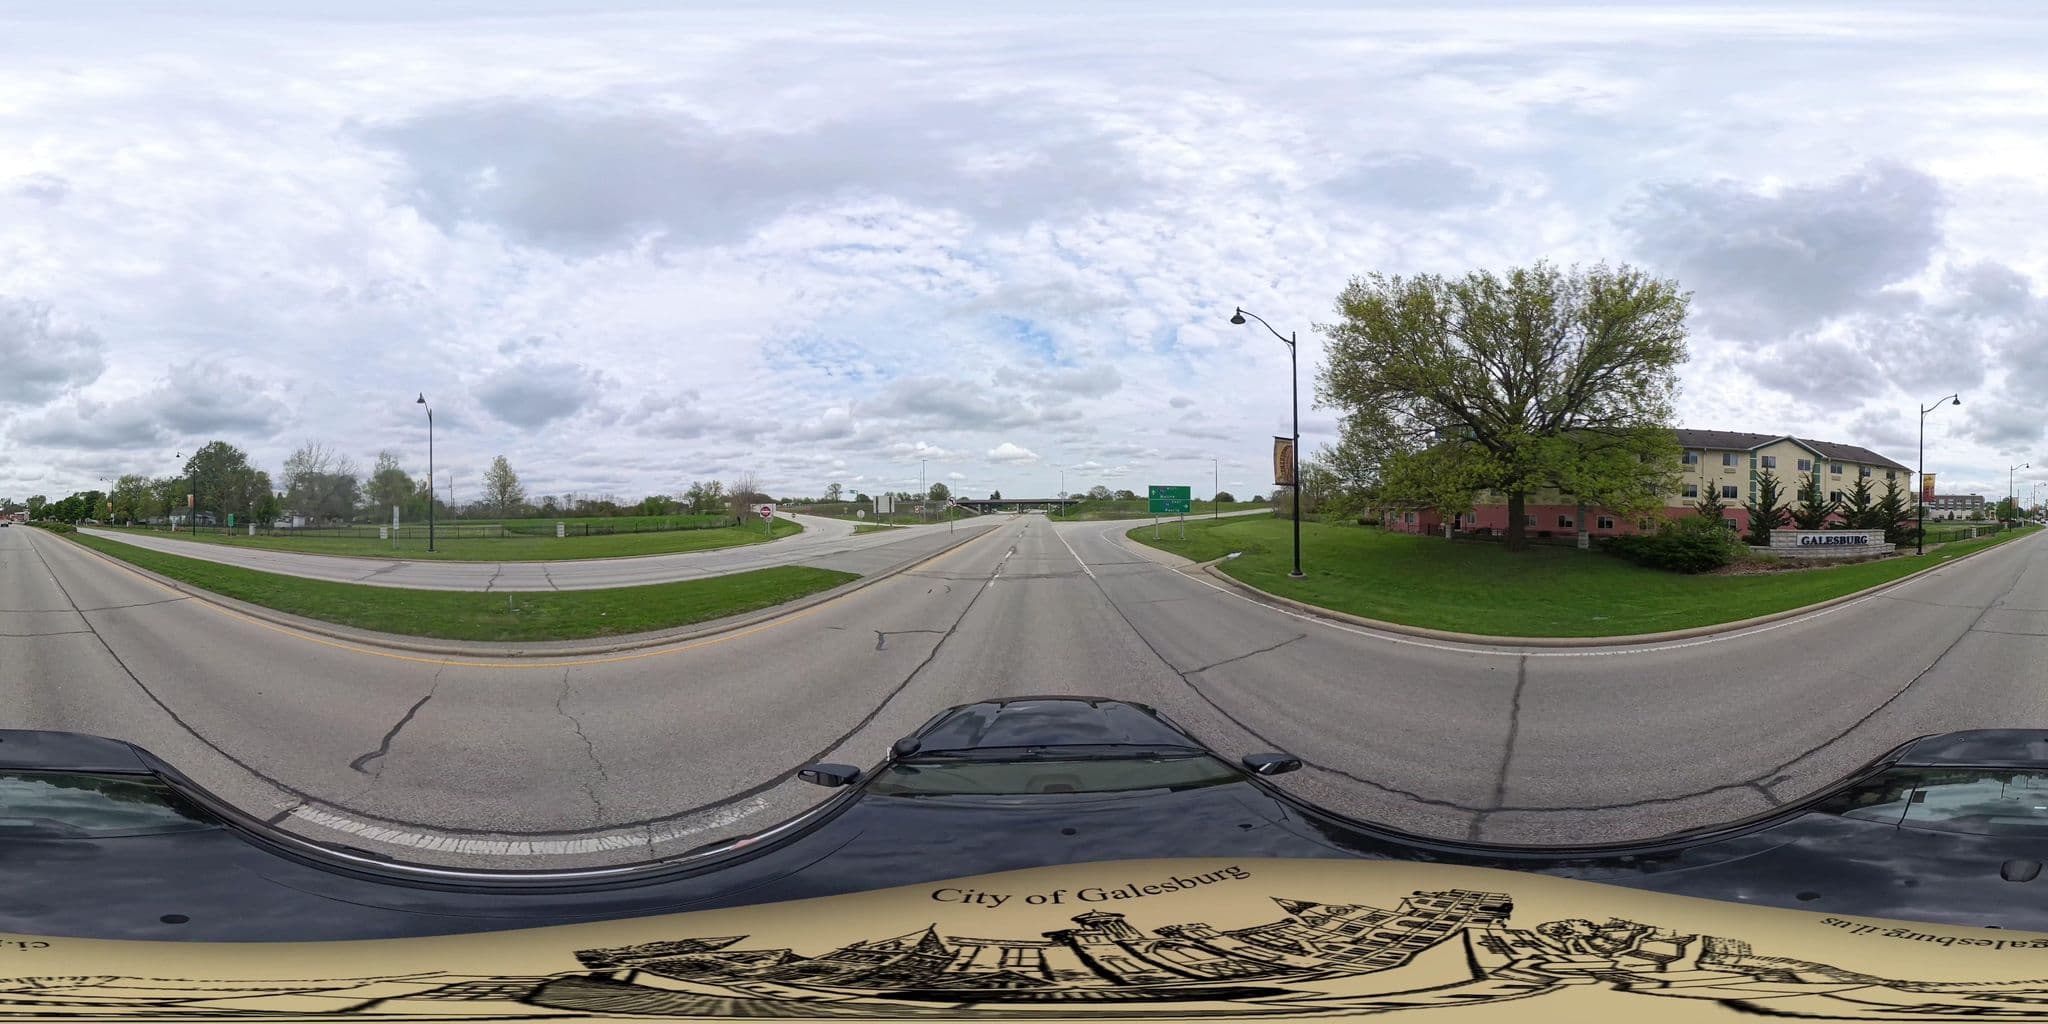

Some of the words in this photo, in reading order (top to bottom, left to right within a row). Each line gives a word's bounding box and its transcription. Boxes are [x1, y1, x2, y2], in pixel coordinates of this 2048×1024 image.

[1801, 535, 1868, 545] GALESBURG
[931, 888, 1012, 909] City
[1025, 889, 1067, 905] of
[1077, 864, 1251, 903] Galesburg
